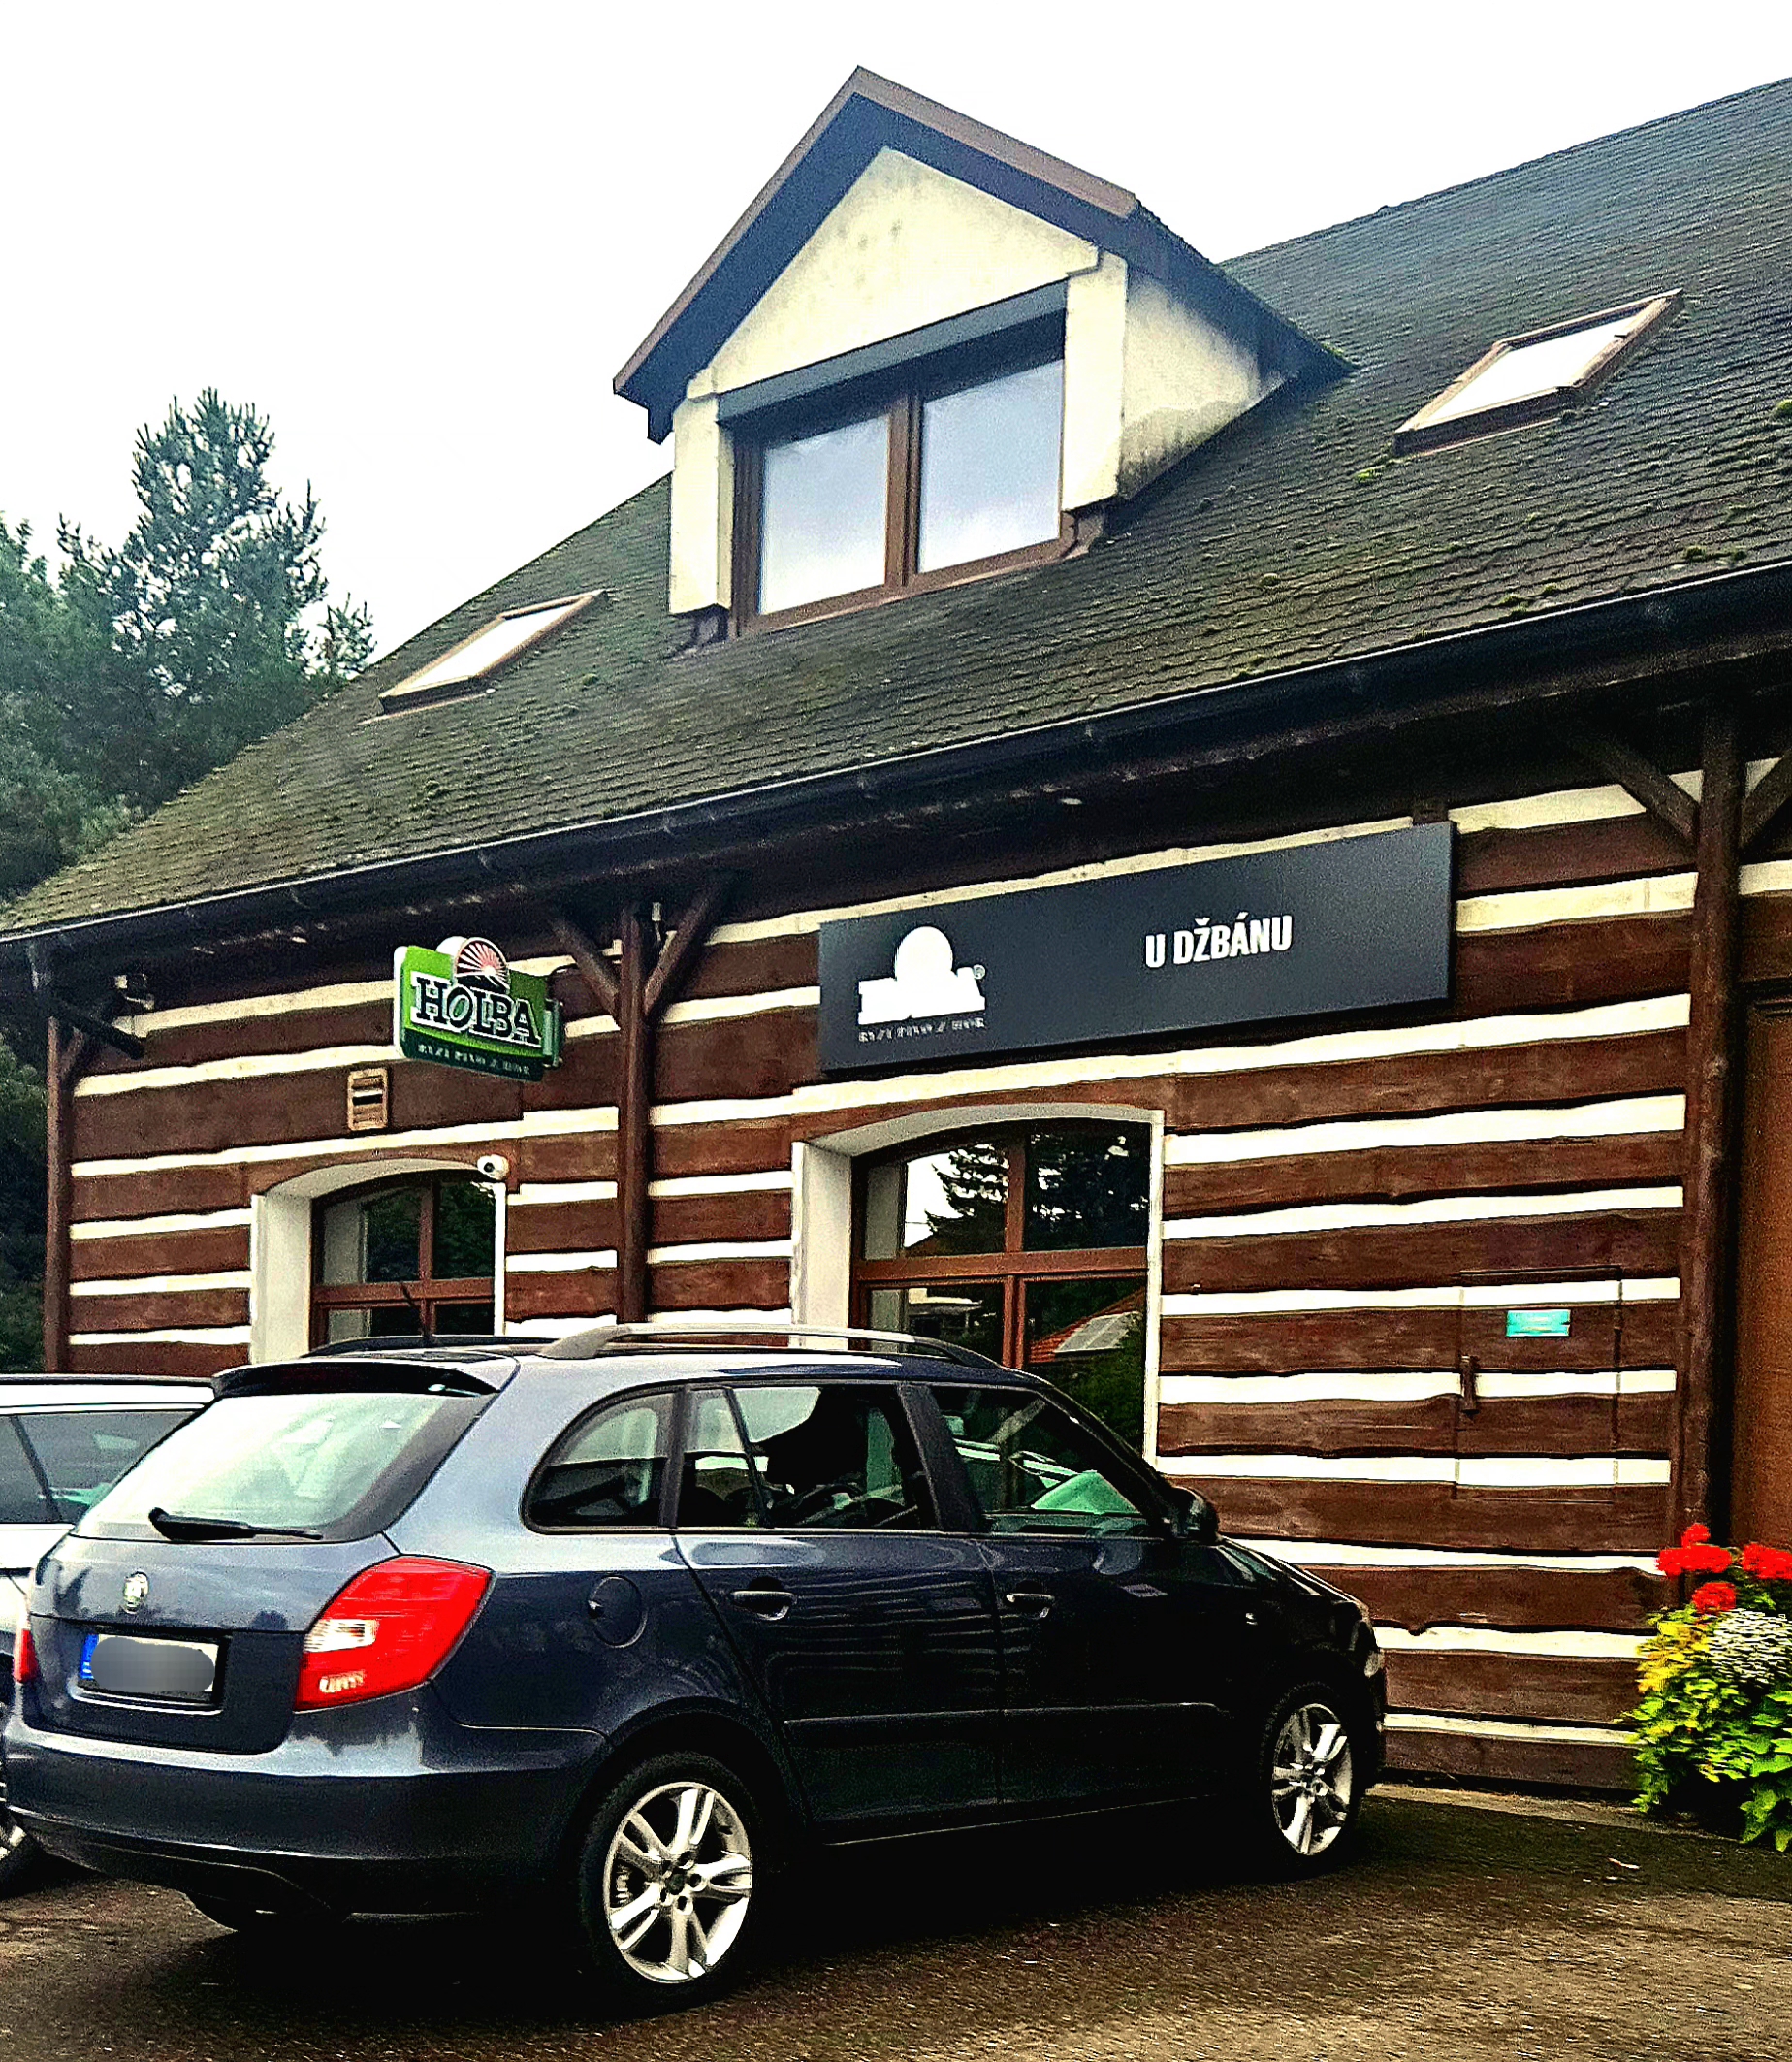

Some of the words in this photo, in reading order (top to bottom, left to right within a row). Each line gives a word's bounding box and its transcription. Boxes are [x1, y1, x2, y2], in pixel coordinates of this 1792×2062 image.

[1145, 934, 1166, 968] U
[1173, 912, 1293, 965] DŽBÁNU
[412, 973, 542, 1047] HOLBA
